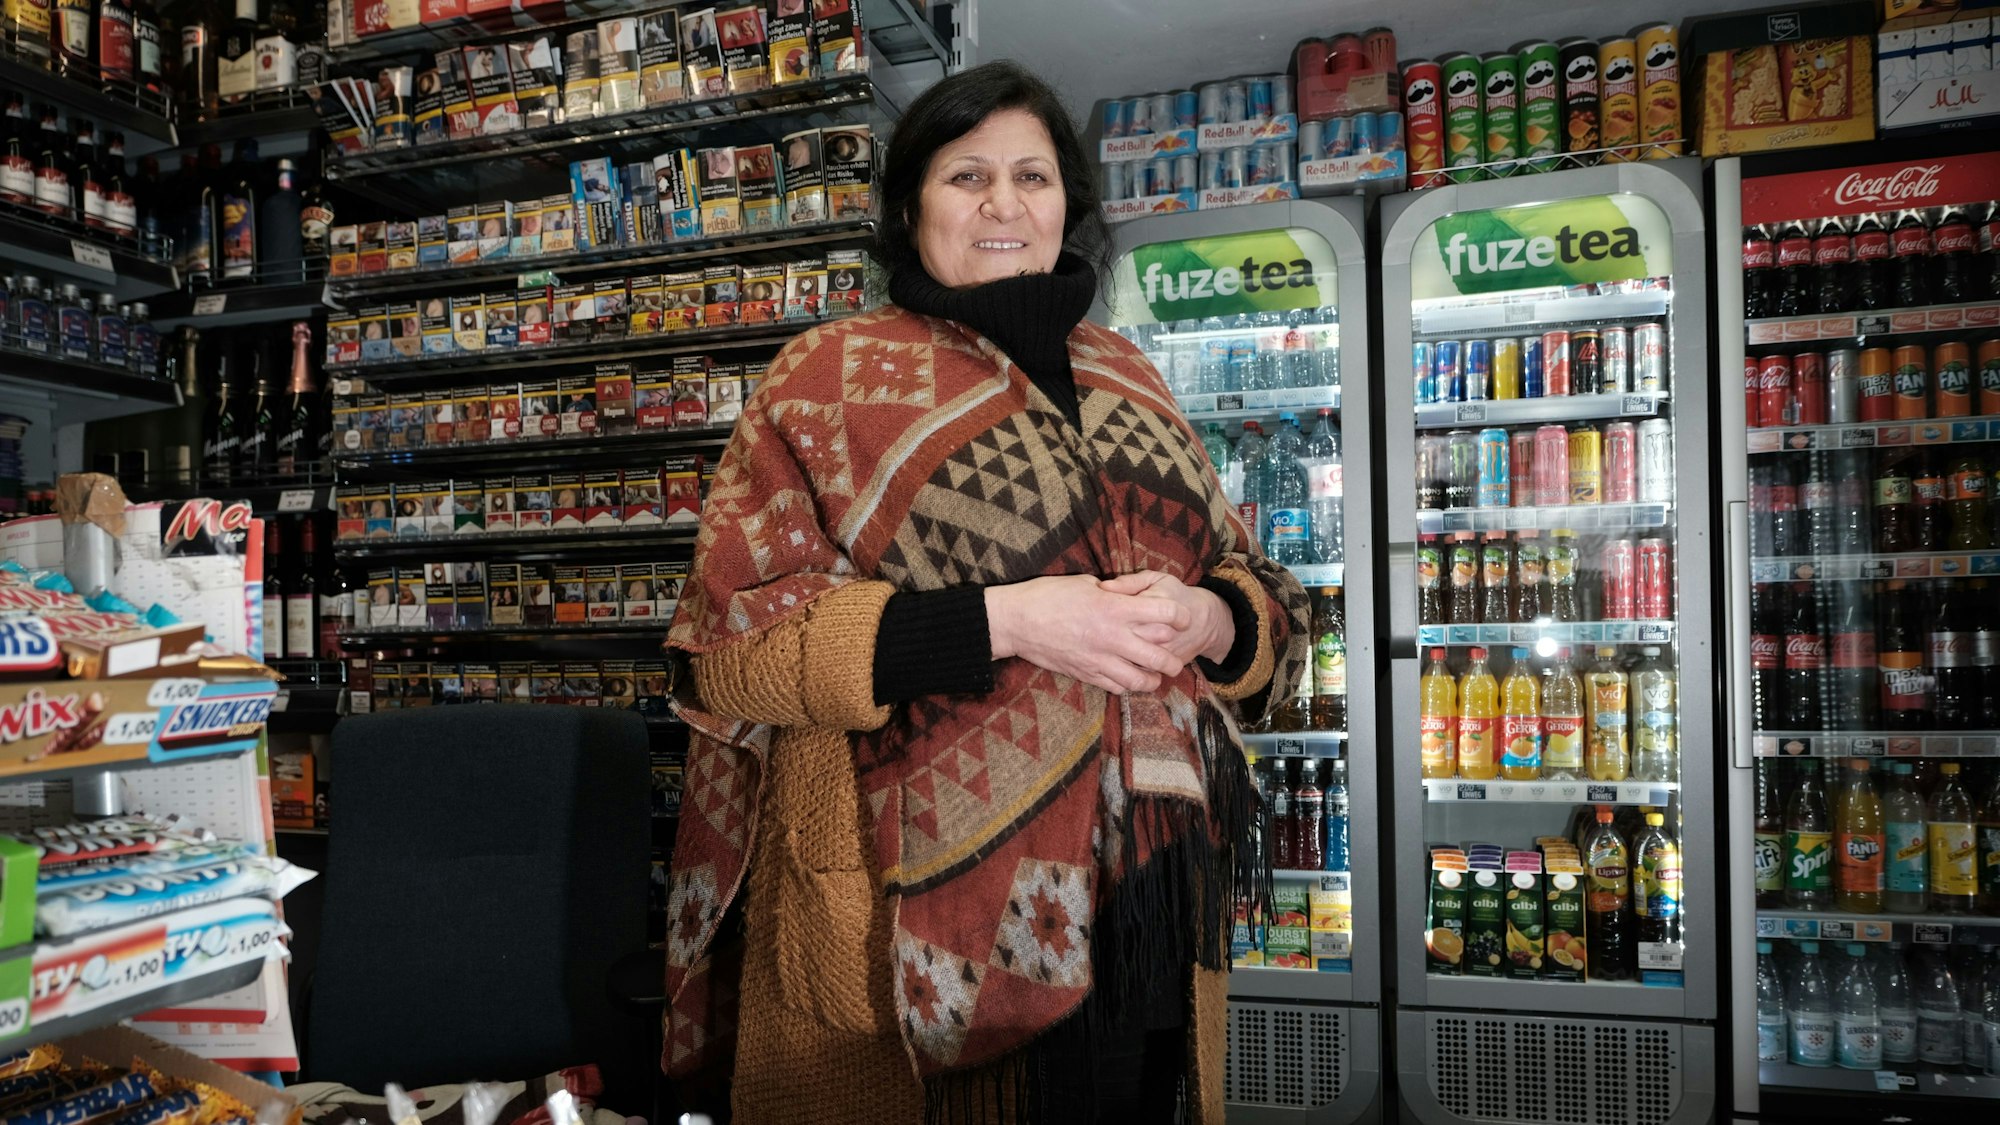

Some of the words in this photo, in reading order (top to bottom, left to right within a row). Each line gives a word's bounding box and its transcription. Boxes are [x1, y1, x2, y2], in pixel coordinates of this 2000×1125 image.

[1645, 68, 1678, 87] PRINGLES
[1524, 85, 1556, 103] PRINGLES
[1567, 80, 1598, 98] PRINGLES
[1604, 82, 1636, 99] PRINGLES
[1448, 94, 1478, 112] PRINGLES
[1486, 96, 1516, 112] PRINGLES
[1407, 105, 1436, 118] PRINGLES
[1204, 128, 1225, 138] Red
[1225, 125, 1245, 138] Bull
[1107, 142, 1127, 153] Red
[1127, 139, 1146, 151] Bull
[1306, 164, 1327, 175] Red
[1328, 161, 1349, 174] Bull
[1834, 164, 1945, 205] Coca-Cola
[1206, 193, 1225, 204] Red
[1226, 190, 1246, 203] Bull
[1107, 204, 1126, 215] Red
[1127, 201, 1145, 213] Bull
[624, 202, 636, 242] DRUM
[707, 219, 736, 231] PUEBLO
[1444, 224, 1642, 277] fuzetea
[1142, 256, 1315, 305] fuzetea
[1894, 374, 1926, 391] FAN
[1939, 371, 1970, 388] FAN
[1627, 403, 1648, 411] EINWEG
[224, 531, 246, 545] Ice
[1643, 631, 1664, 640] EINWEG
[164, 684, 200, 700] 1,00
[0, 688, 79, 743] wix
[120, 719, 157, 737] 1,00
[1461, 791, 1482, 799] EINWEG
[1592, 792, 1613, 801] EINWEG
[1792, 844, 1833, 878] Sprit
[1598, 866, 1626, 877] Lipton
[1273, 887, 1304, 897] URST
[1436, 900, 1461, 909] albi
[1473, 899, 1498, 909] albi
[1511, 901, 1537, 911] albi
[1552, 902, 1578, 912] albi
[239, 930, 271, 954] 1,00
[124, 957, 160, 984] 1,00
[0, 1006, 21, 1028] 00
